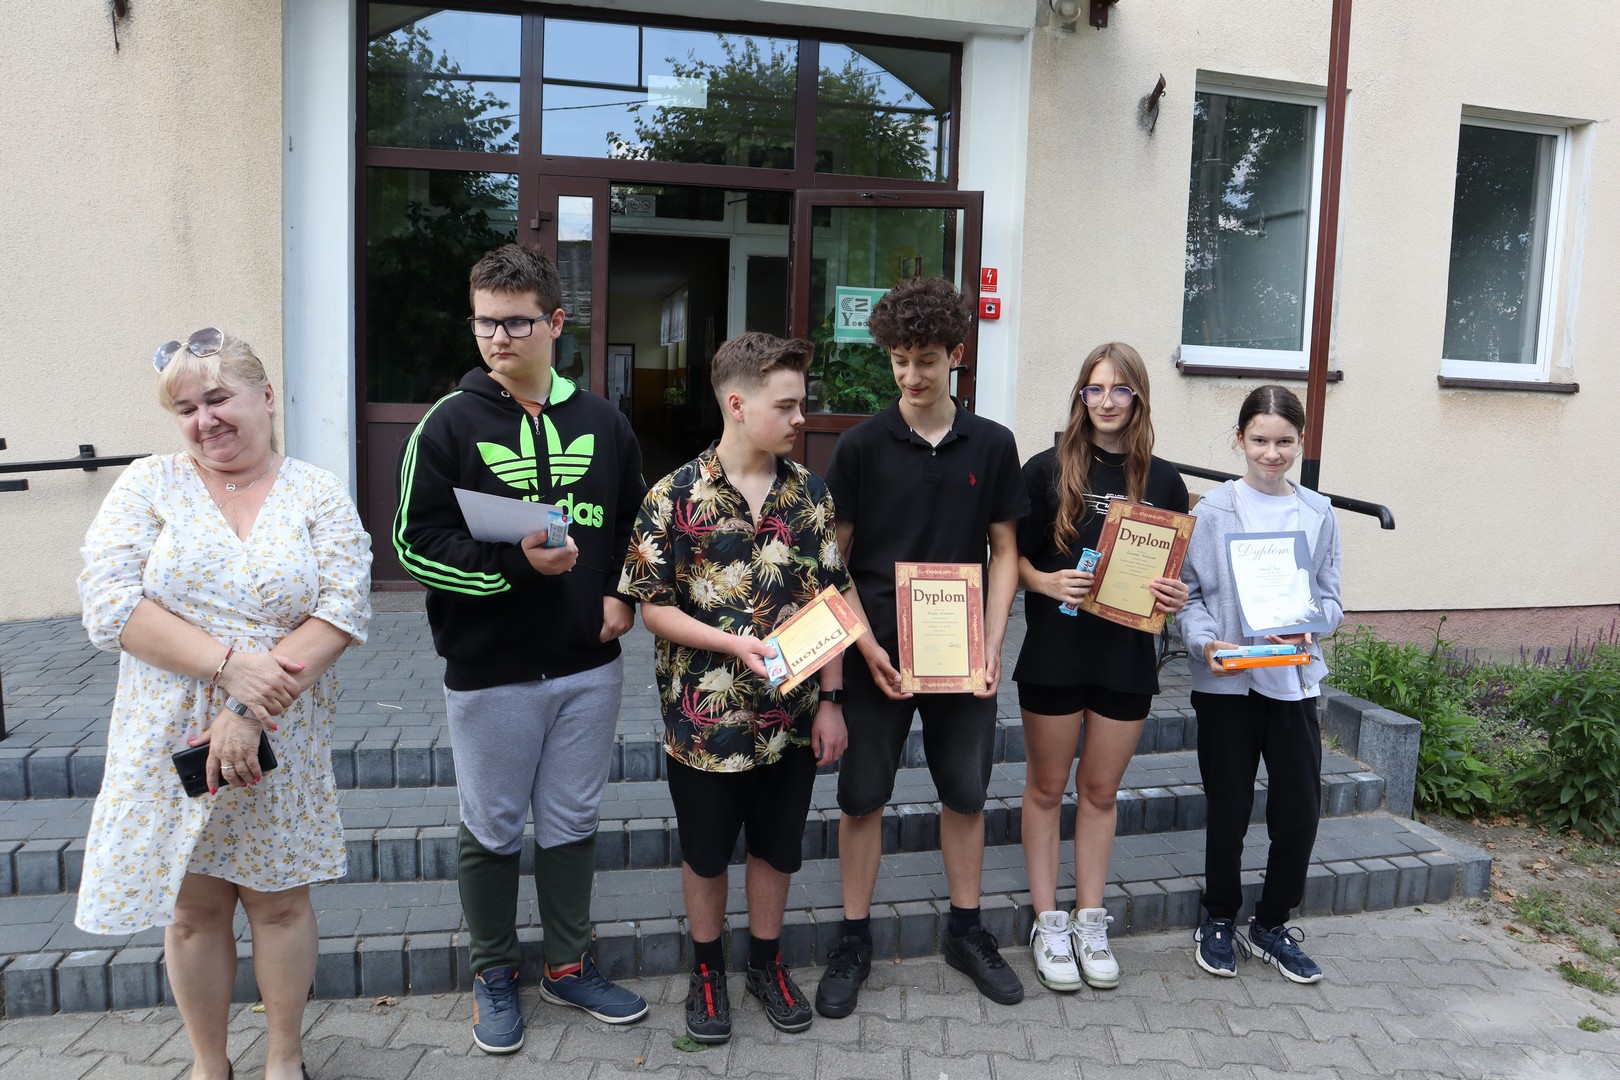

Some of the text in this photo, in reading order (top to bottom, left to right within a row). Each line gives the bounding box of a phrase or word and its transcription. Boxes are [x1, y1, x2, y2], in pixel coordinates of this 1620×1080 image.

[1118, 527, 1171, 550] Dyplom
[1236, 543, 1289, 561] Dyplom
[913, 588, 966, 605] Dyplom
[791, 628, 844, 668] Dyplom
